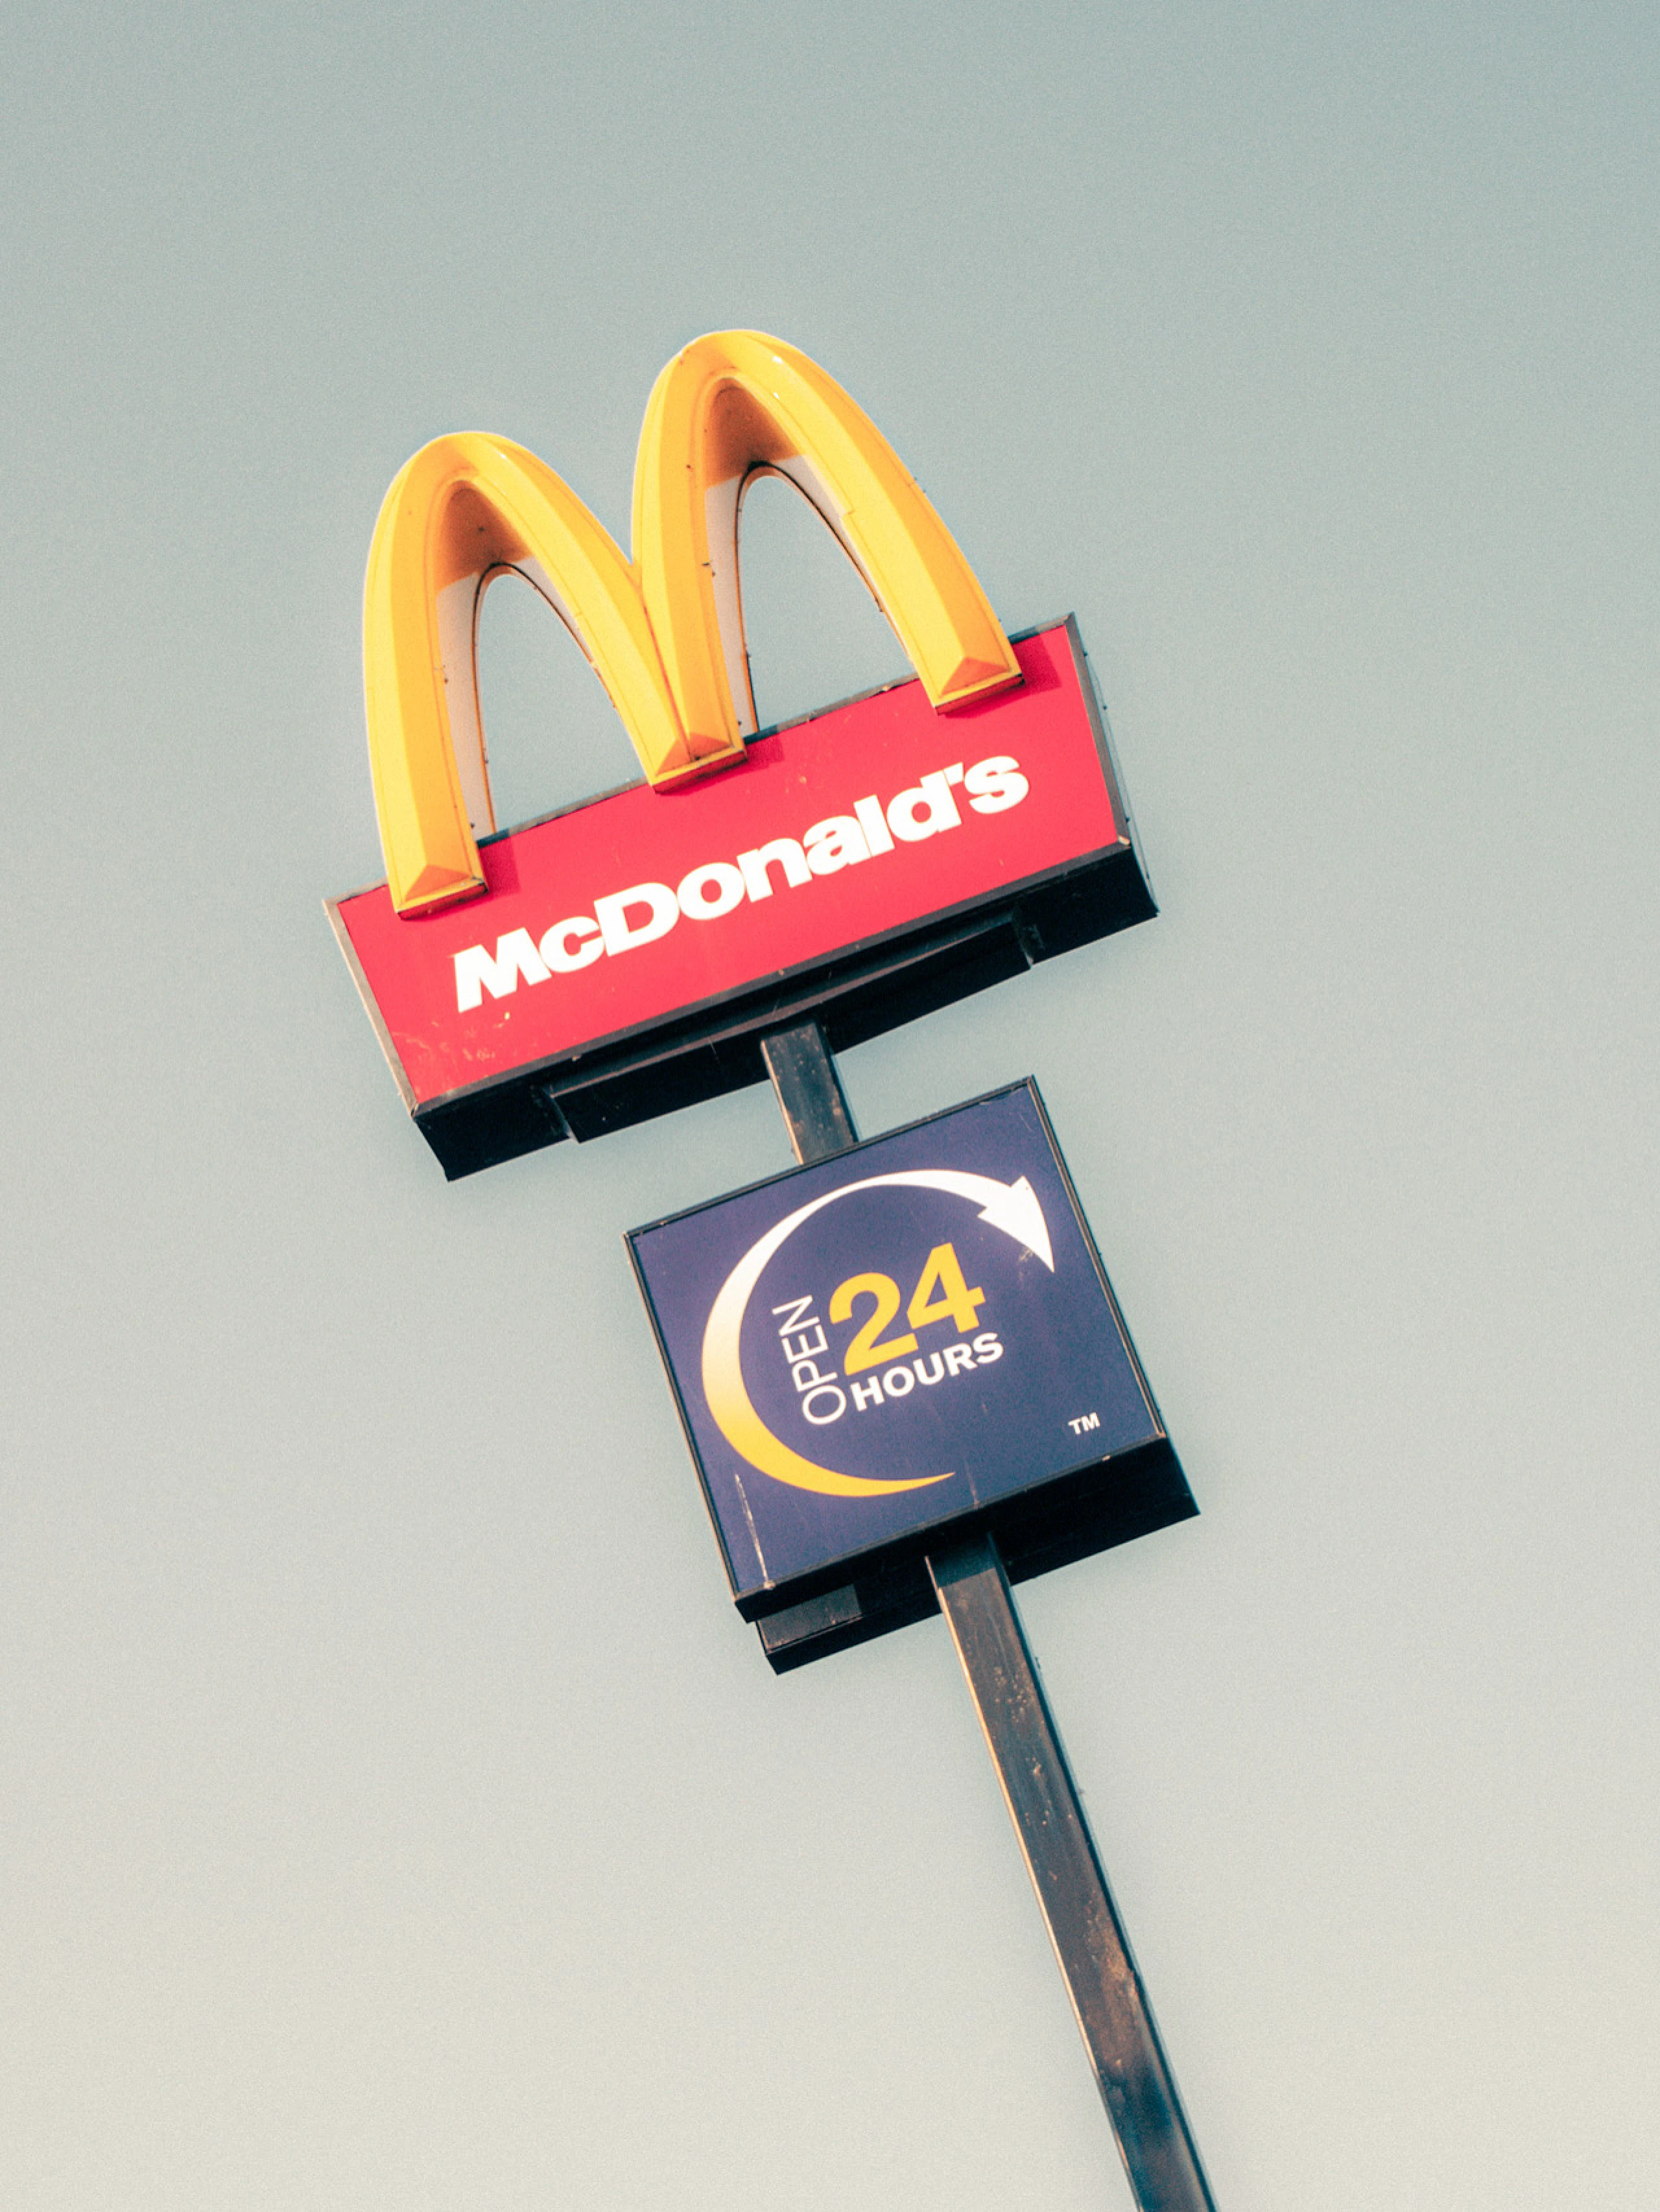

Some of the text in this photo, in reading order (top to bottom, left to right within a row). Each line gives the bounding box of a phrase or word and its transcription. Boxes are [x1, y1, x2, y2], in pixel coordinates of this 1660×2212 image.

[453, 755, 1030, 1013] McDonald's
[772, 1295, 847, 1426] OPEN
[829, 1242, 986, 1376] 24
[849, 1332, 1004, 1413] HOURS
